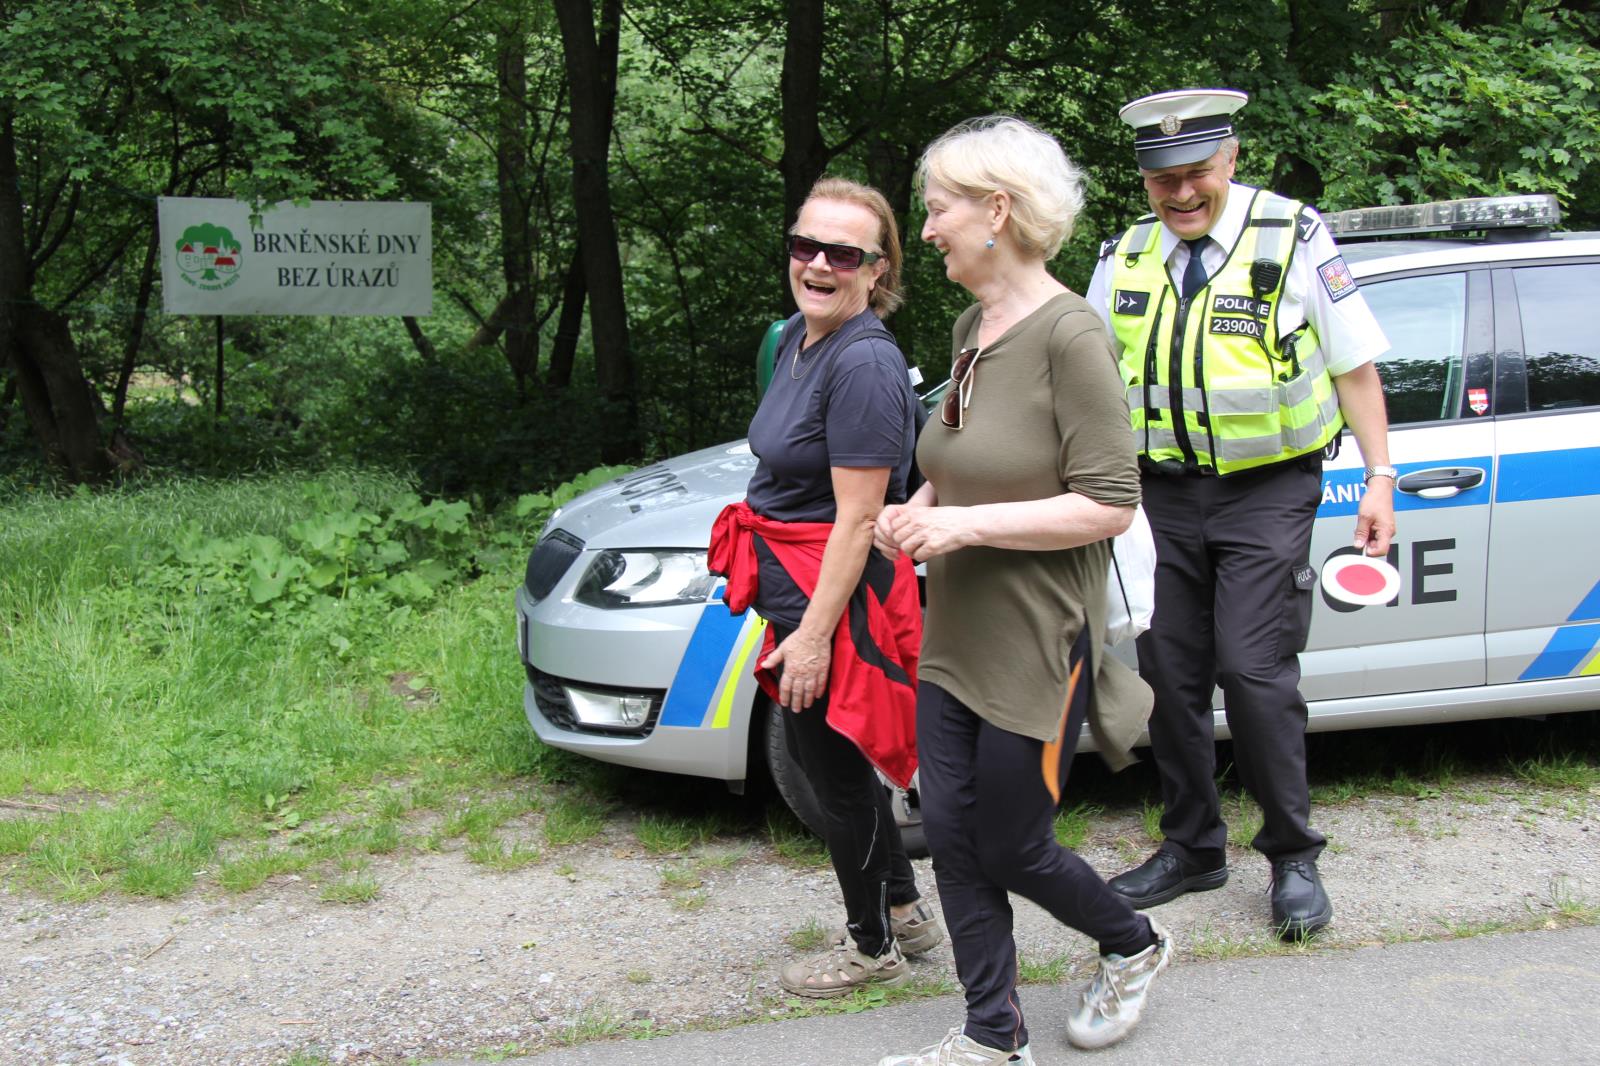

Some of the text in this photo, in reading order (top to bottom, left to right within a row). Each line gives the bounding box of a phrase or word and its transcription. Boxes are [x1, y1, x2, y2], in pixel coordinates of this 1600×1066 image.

[253, 228, 421, 254] BRNĚNSKÉ DNY
[278, 261, 399, 288] BEZ ÚRAZŮ
